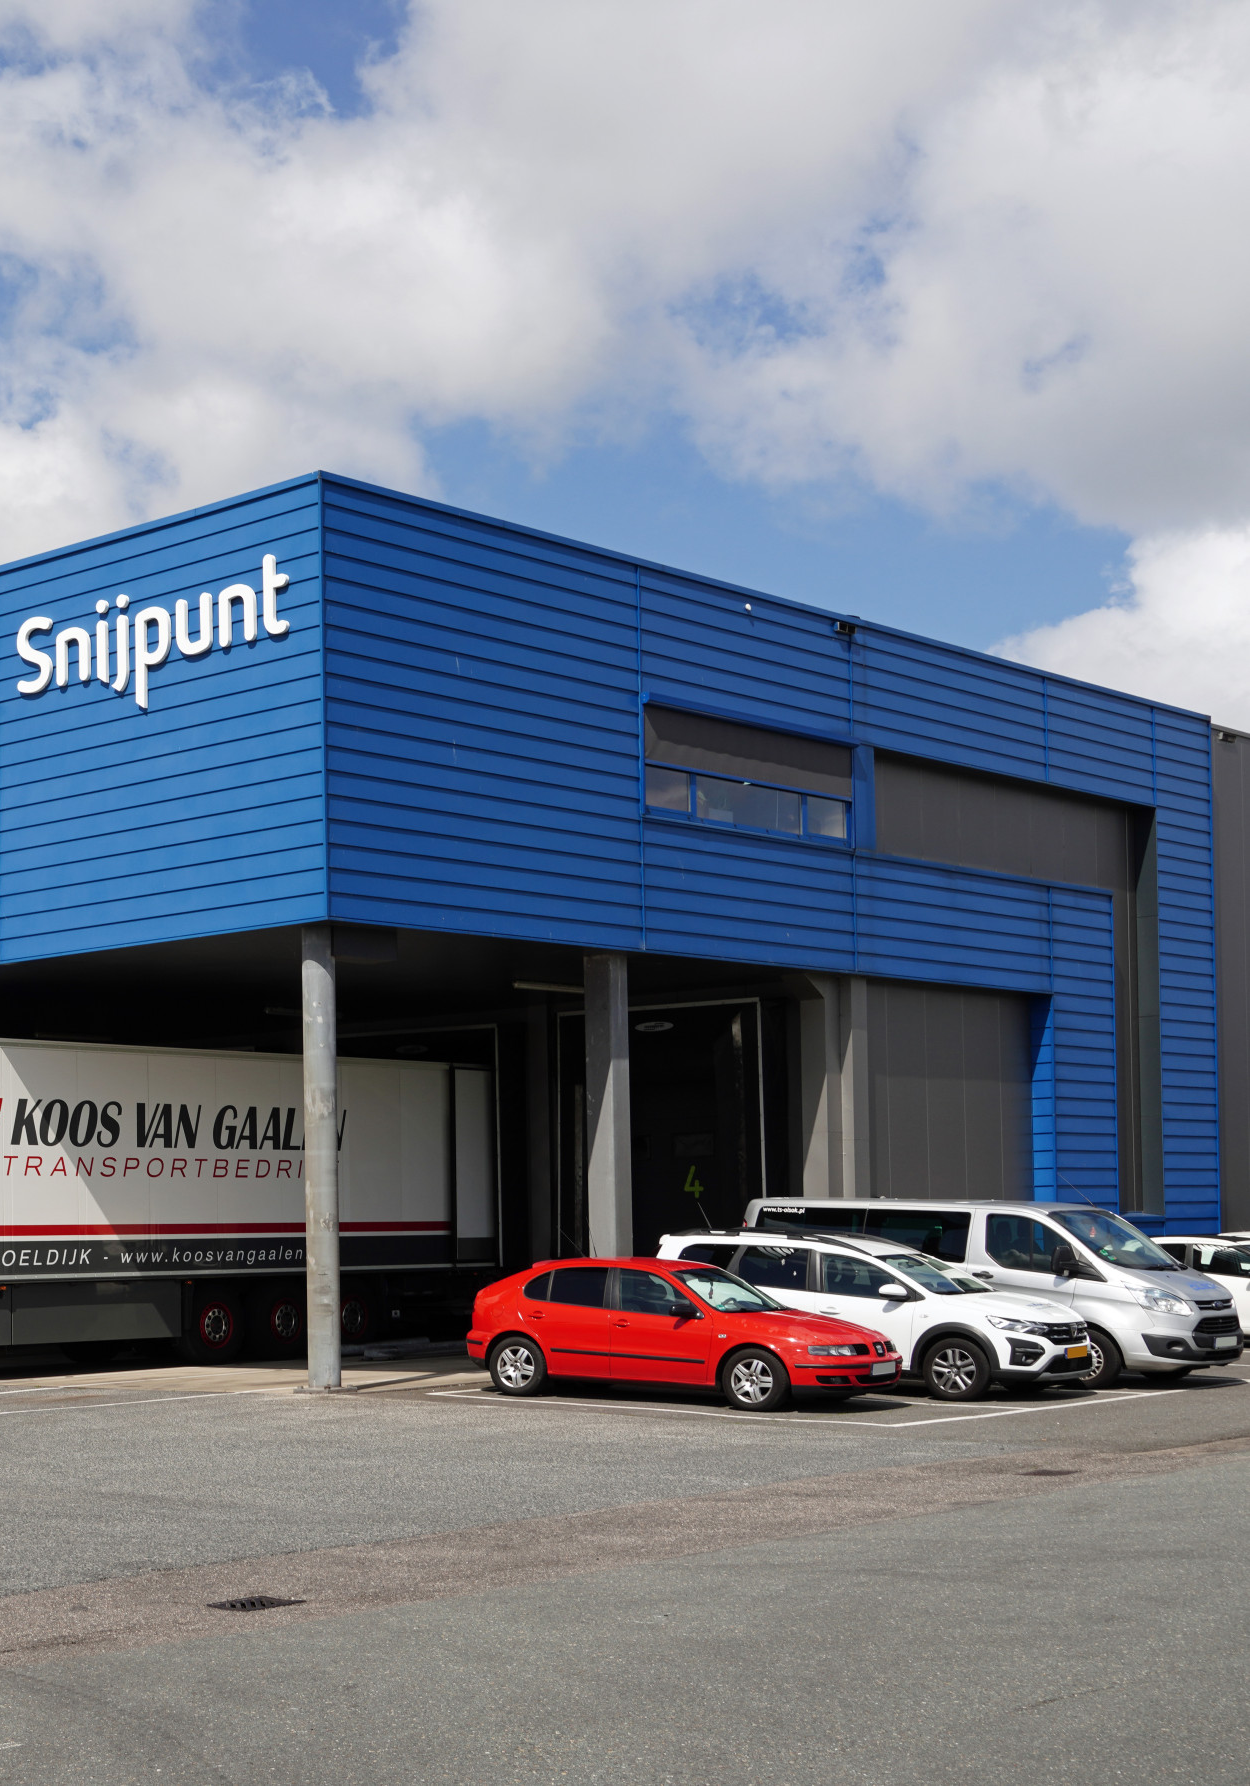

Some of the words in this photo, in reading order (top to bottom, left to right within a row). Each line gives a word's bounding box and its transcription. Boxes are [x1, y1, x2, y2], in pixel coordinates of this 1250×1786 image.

[16, 553, 290, 709] Snijpunt
[11, 1098, 123, 1148] KOOS
[136, 1102, 202, 1149] VAN
[213, 1104, 347, 1152] GAAL
[3, 1155, 303, 1179] TRANSPORTBEDRI
[684, 1165, 704, 1198] 4
